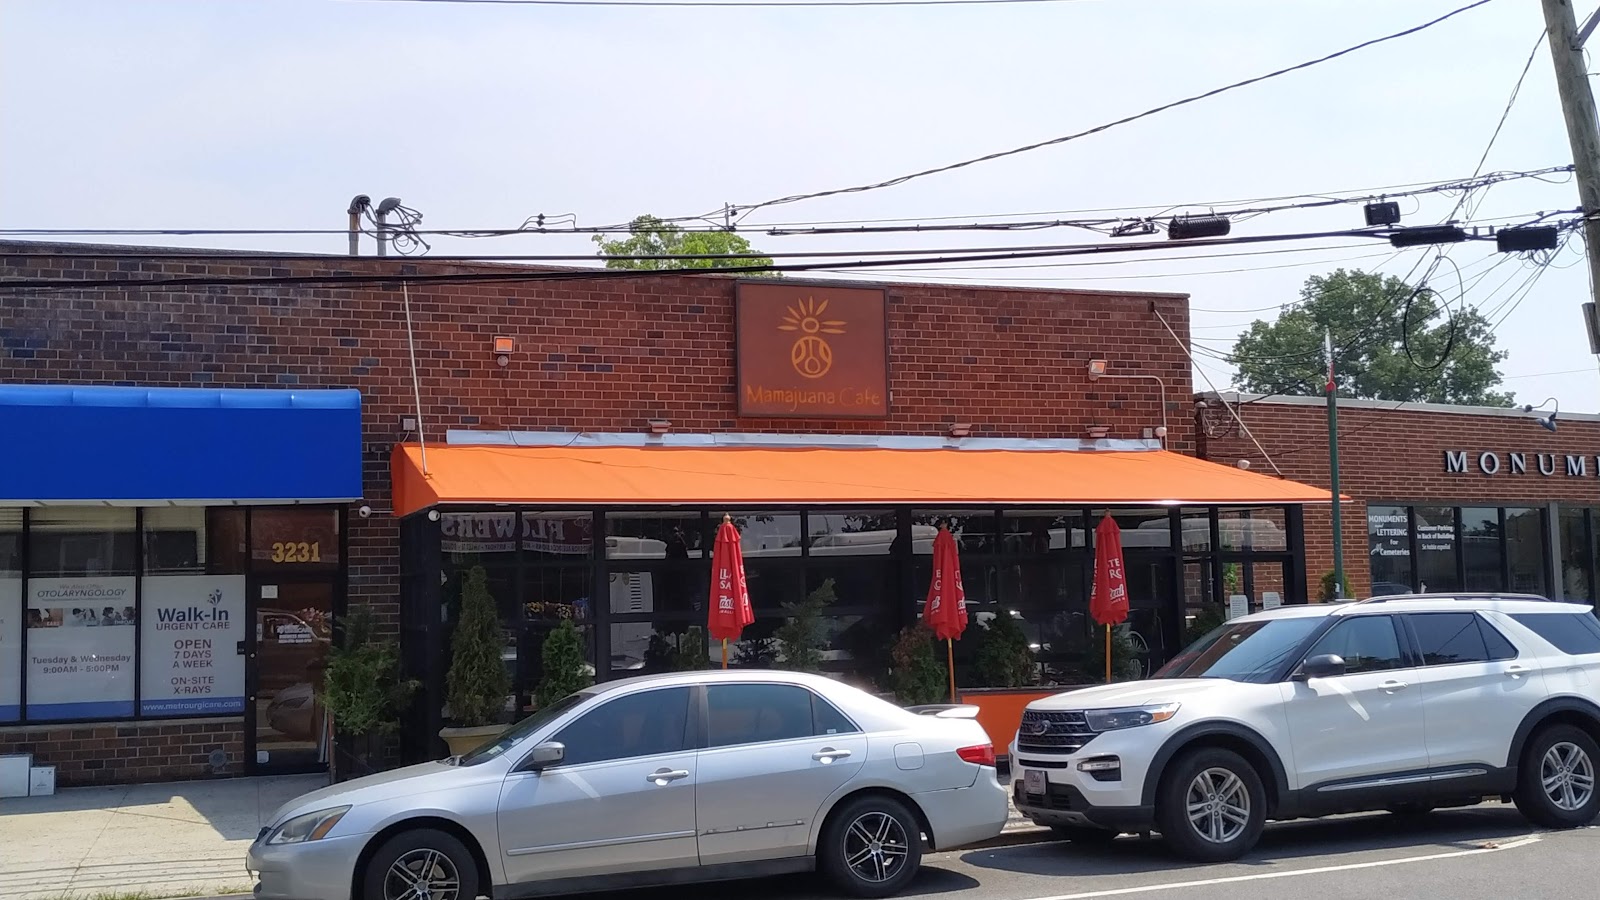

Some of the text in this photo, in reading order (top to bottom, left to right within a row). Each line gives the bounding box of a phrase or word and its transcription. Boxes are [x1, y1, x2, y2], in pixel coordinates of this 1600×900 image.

[746, 384, 835, 412] Mamajuana
[1368, 515, 1408, 523] MONUMENTS
[1376, 528, 1408, 536] LETTERING
[271, 541, 321, 563] 3231
[37, 588, 127, 598] OTOLARYNGOLOGY
[157, 607, 229, 622] Walk-In
[156, 621, 230, 631] URGENT CARE
[174, 639, 212, 650] OPEN
[32, 653, 131, 665] Tuesday & Wednesday
[174, 650, 212, 659] 7 DAYS
[43, 665, 78, 674] 9:00AM
[86, 664, 120, 672] 5:00PM
[172, 660, 213, 668] A WEEK
[171, 676, 215, 685] ON-SITE
[173, 685, 211, 694] X-RAYS
[143, 700, 241, 711] www.metrourgicare.com
